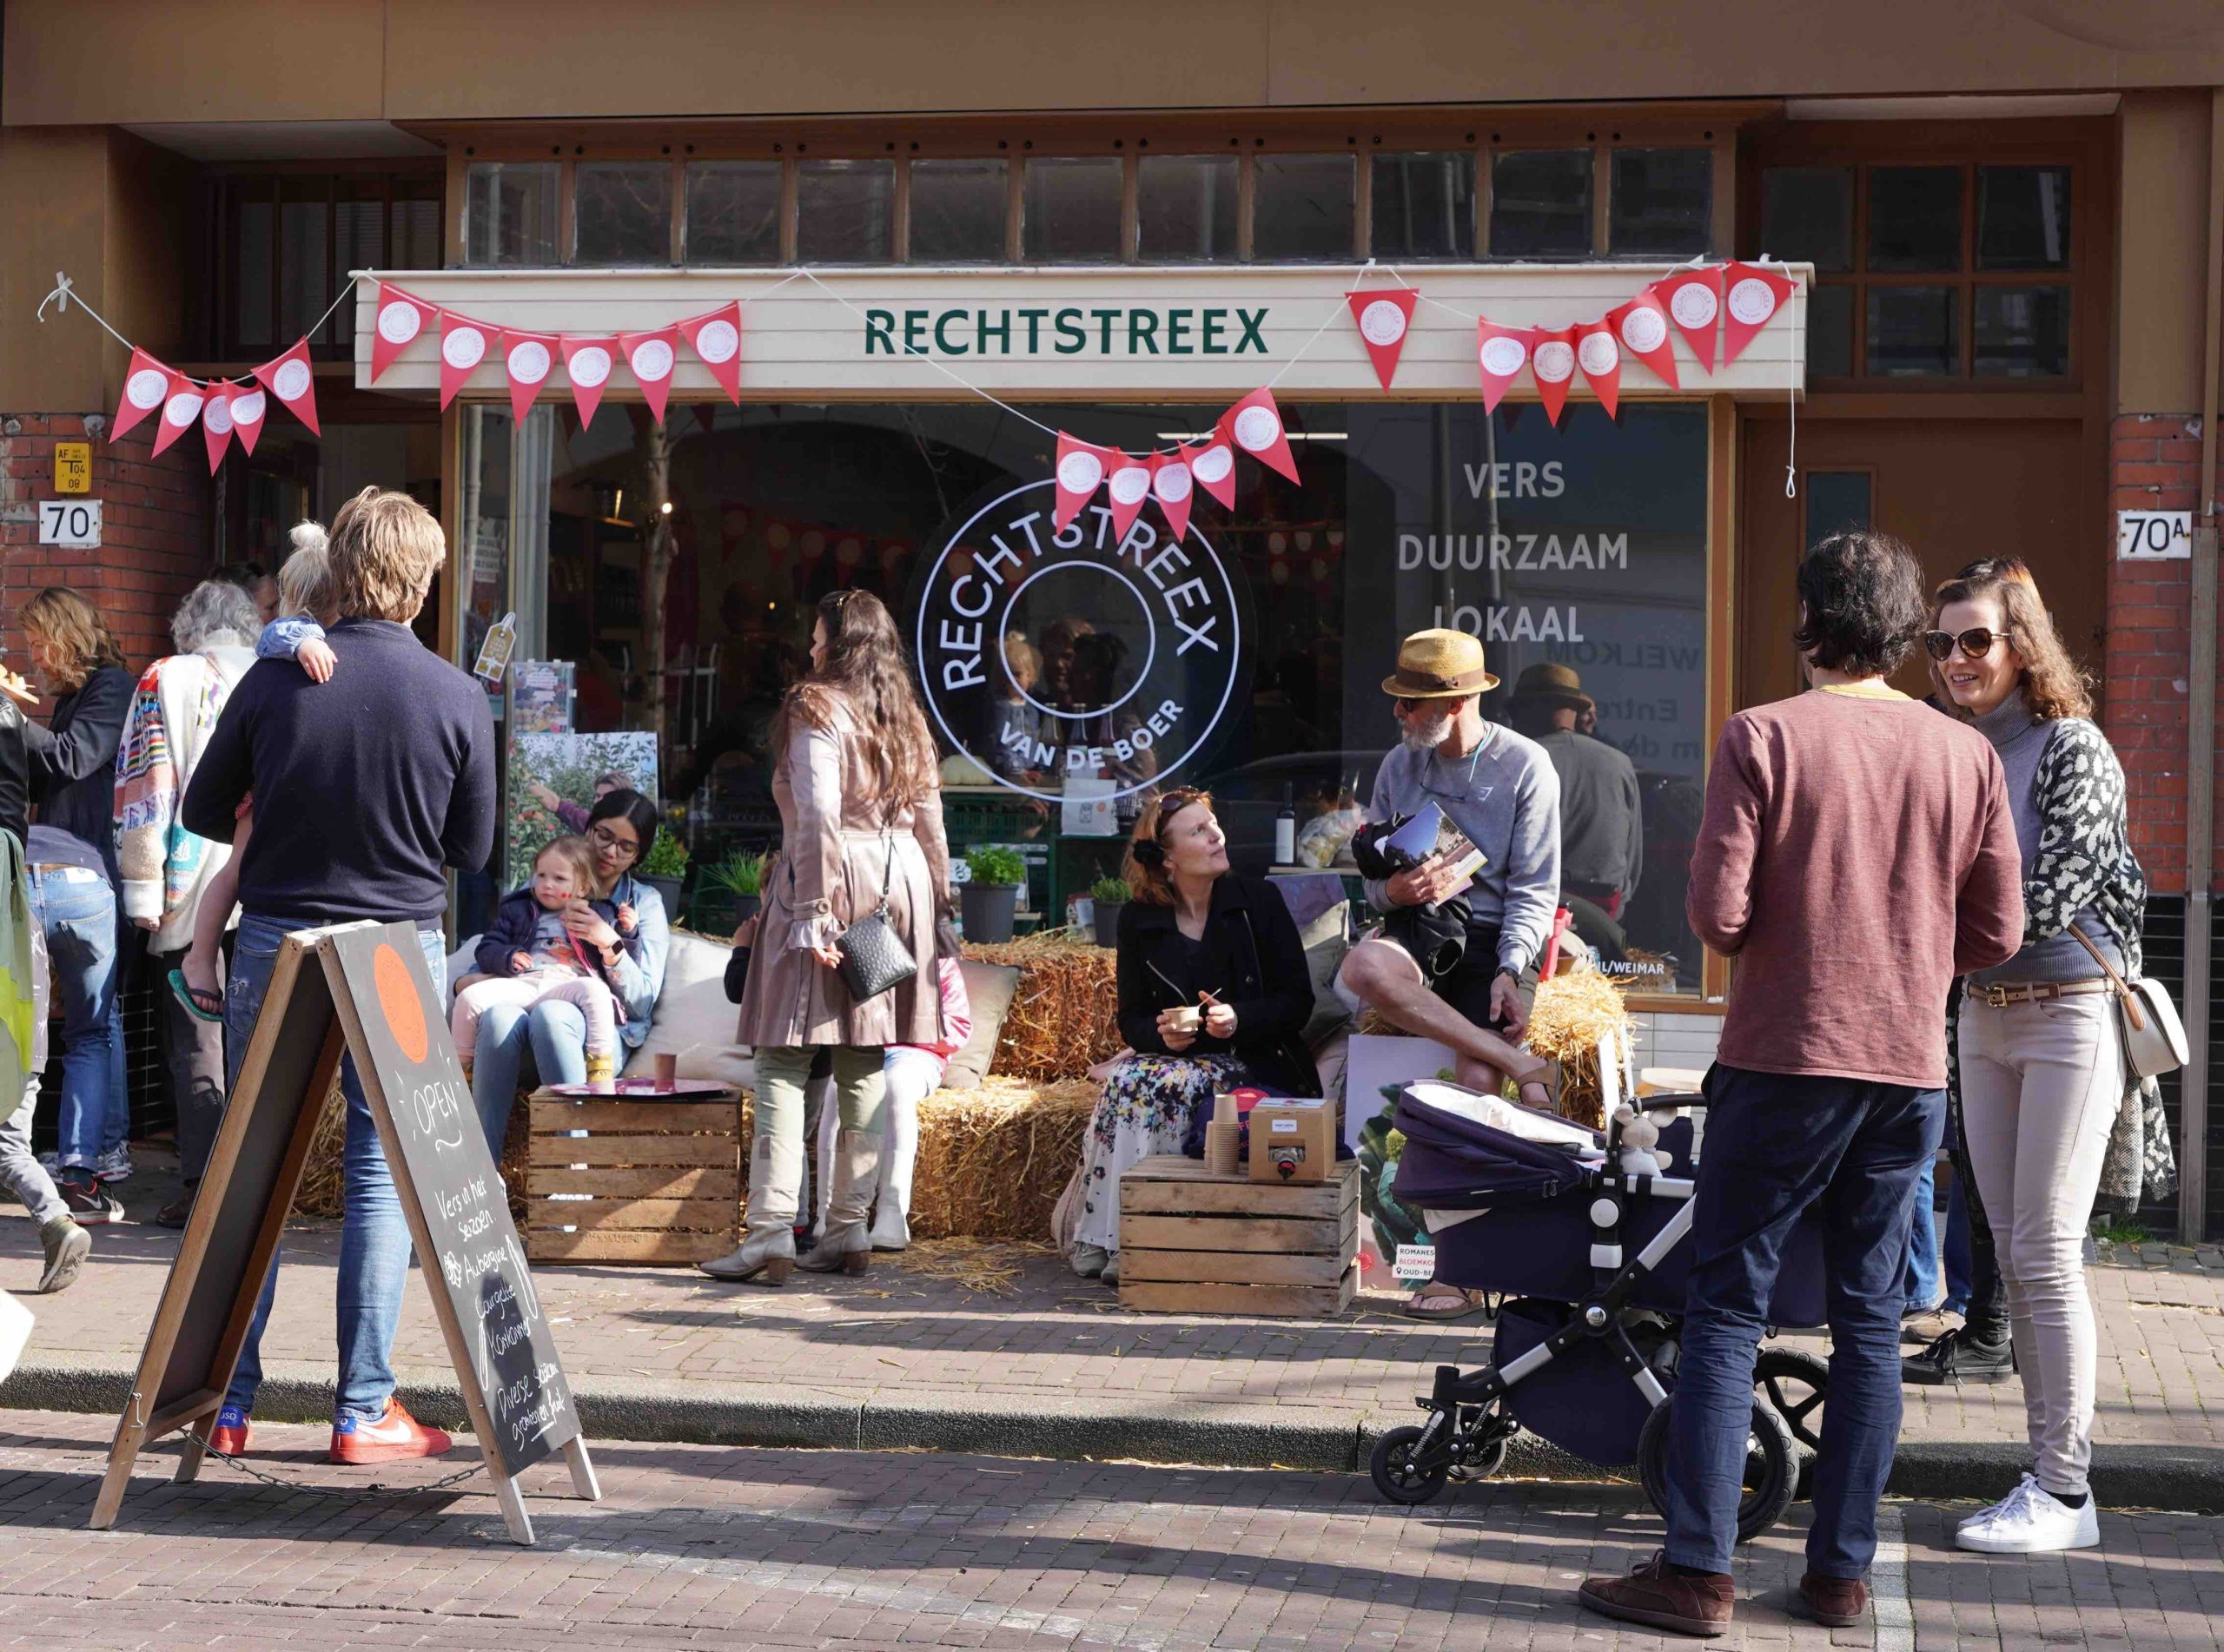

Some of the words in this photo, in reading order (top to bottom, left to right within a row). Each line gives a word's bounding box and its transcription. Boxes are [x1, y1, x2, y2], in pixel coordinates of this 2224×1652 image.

[865, 307, 1270, 355] RECHTSTREEX
[58, 449, 69, 459] AF
[1464, 461, 1565, 499] VERS
[47, 506, 89, 539] 70
[2125, 517, 2186, 553] 70A
[1399, 534, 1628, 571] DUURZAAM
[939, 505, 1219, 691] RECHTSTREEX
[999, 721, 1056, 768] VAN
[1067, 746, 1106, 770] DE
[1112, 698, 1185, 763] BOER
[414, 1081, 459, 1134] OPEN
[434, 1189, 462, 1222] Vers
[461, 1186, 472, 1205] in
[468, 1174, 487, 1210] het
[463, 1246, 508, 1284] Aubergine
[1400, 1247, 1434, 1256] ROMANES
[474, 1276, 516, 1320] Courgette
[497, 1375, 533, 1423] Diverse
